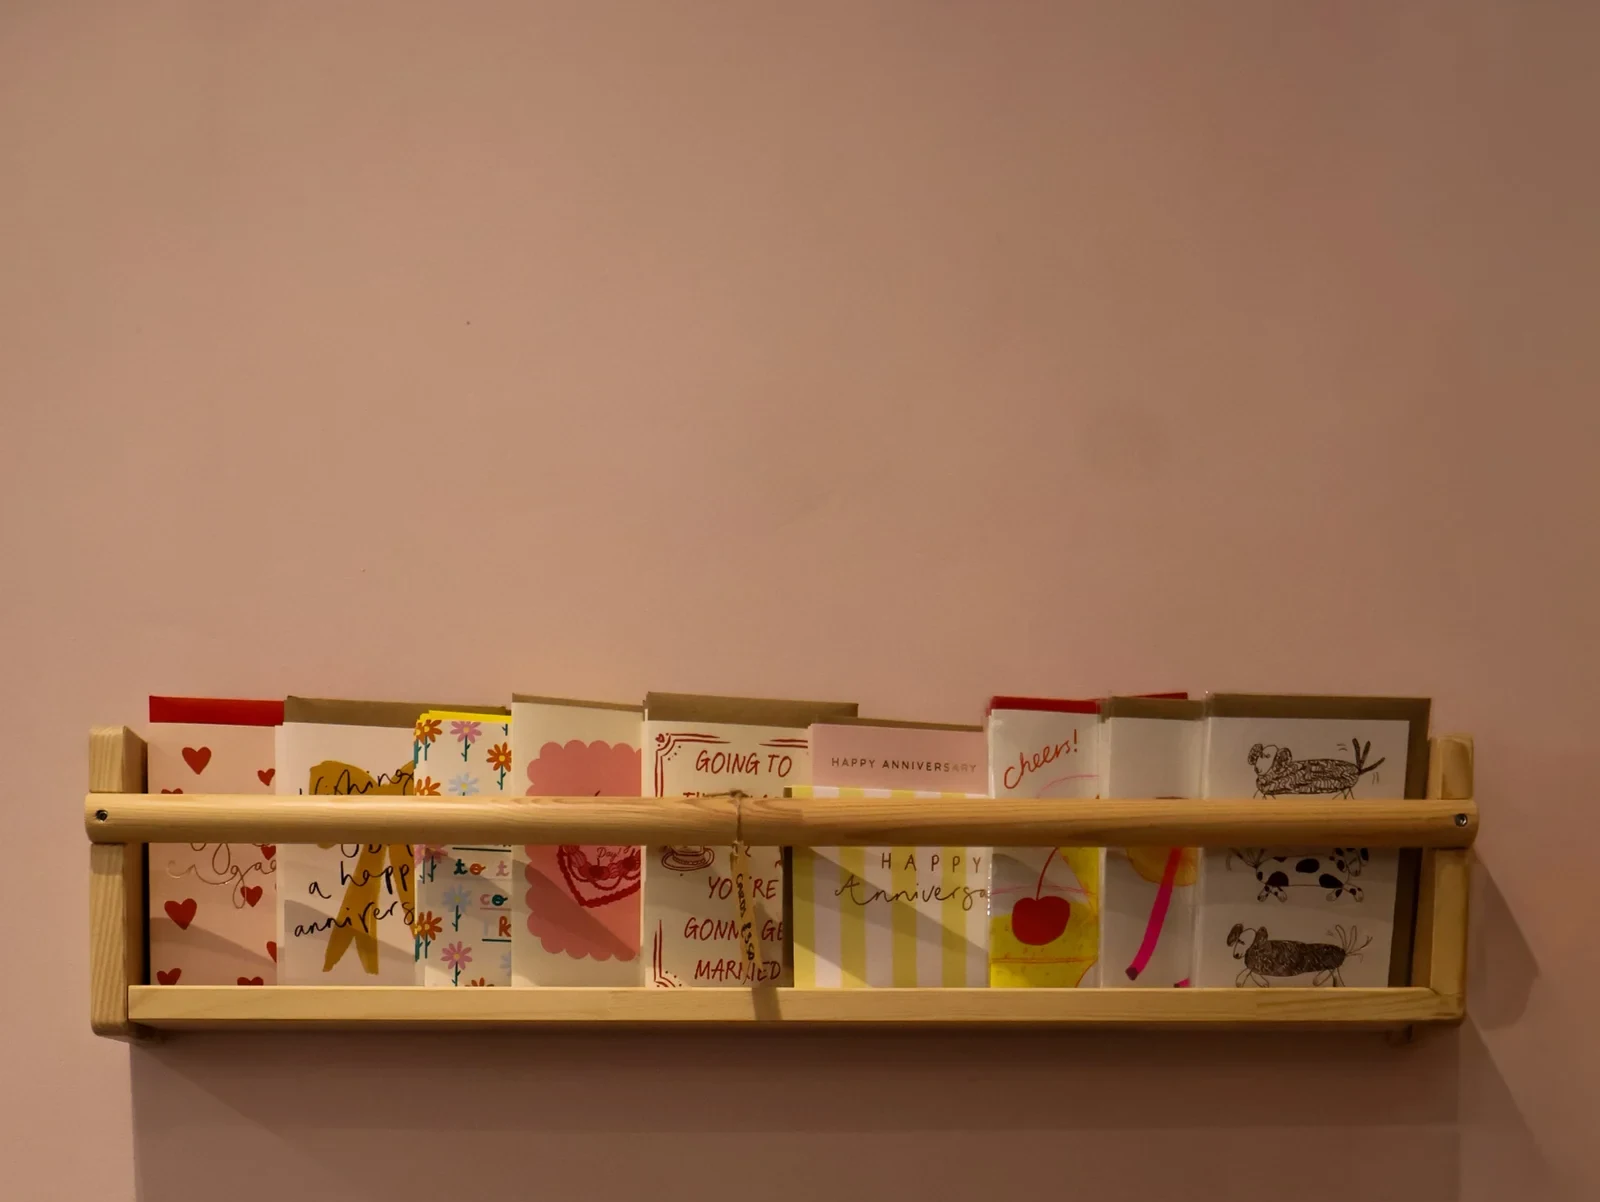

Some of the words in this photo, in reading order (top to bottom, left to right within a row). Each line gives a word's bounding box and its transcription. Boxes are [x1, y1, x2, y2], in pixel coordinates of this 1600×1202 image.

[695, 750, 760, 776] GOING
[768, 754, 793, 777] TO
[831, 757, 876, 768] HAPPY
[882, 760, 977, 773] ANNIVERSARY
[882, 852, 981, 873] HAPPY
[308, 881, 332, 900] a
[708, 876, 779, 900] YO'RE
[684, 917, 741, 941] GONN
